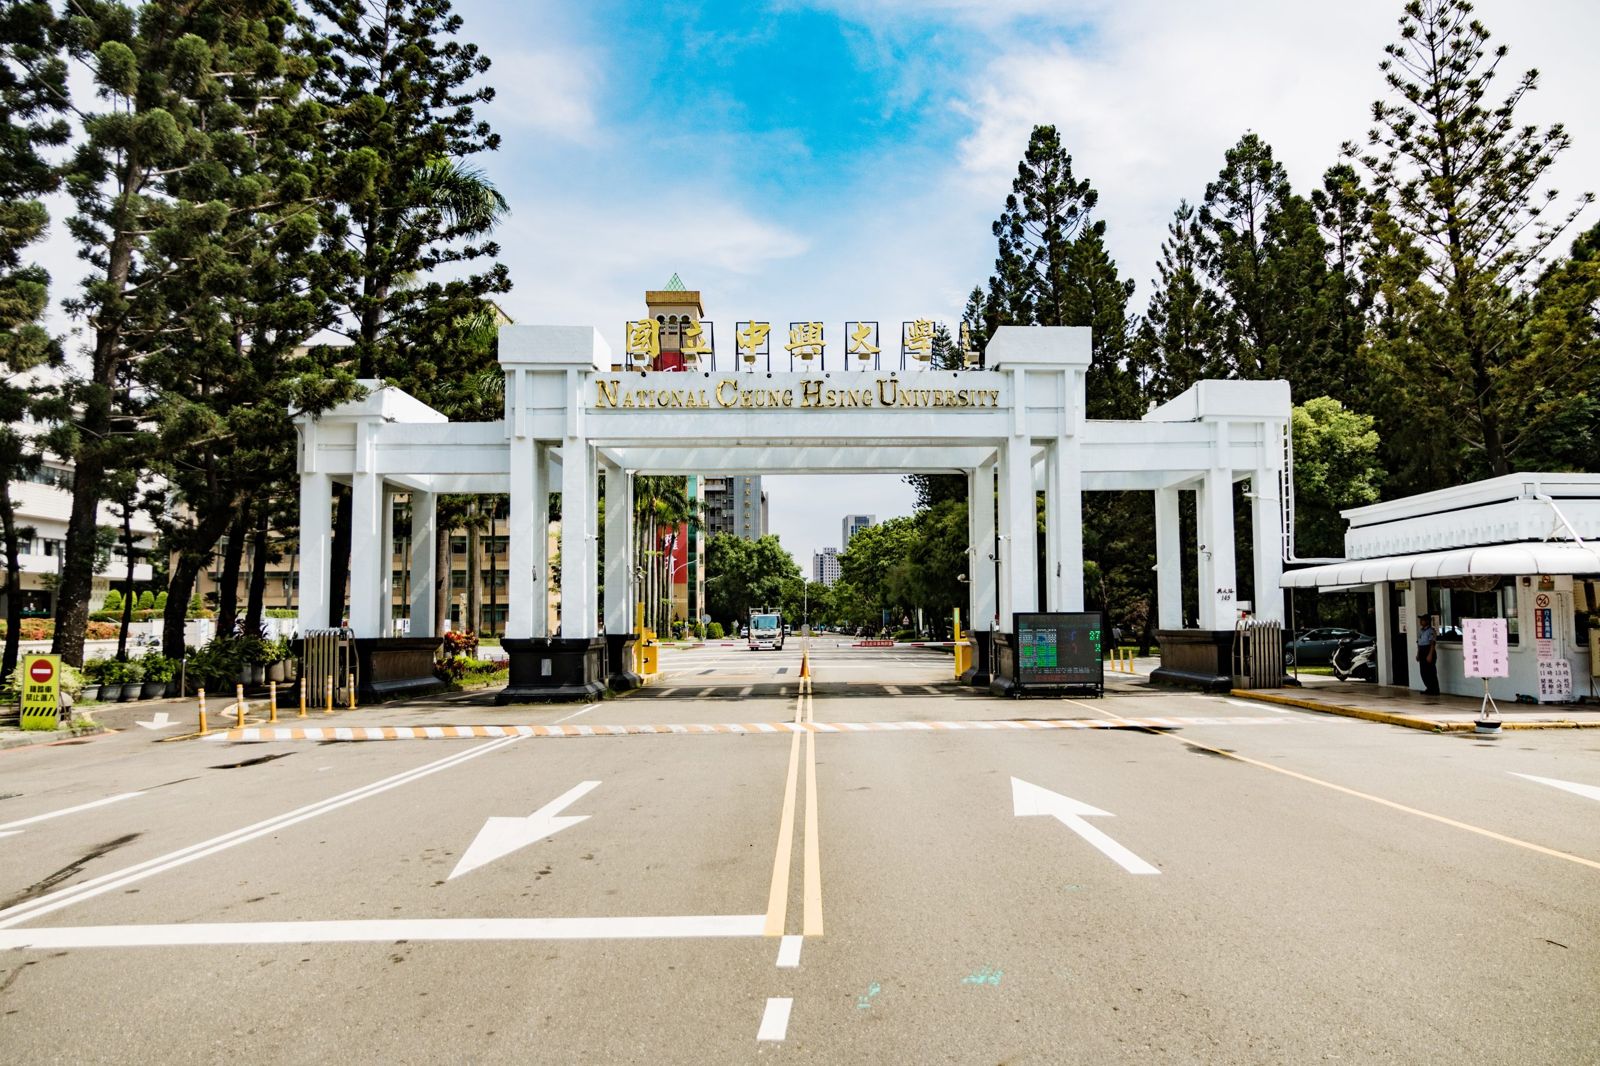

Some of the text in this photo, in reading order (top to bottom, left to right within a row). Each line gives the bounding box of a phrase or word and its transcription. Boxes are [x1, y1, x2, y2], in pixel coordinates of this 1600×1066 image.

[626, 318, 938, 361] 國立中興大學
[595, 379, 1000, 408] NATIONAL CHUNG HSING UNIVERSITY
[26, 693, 56, 702] 禁止進入
